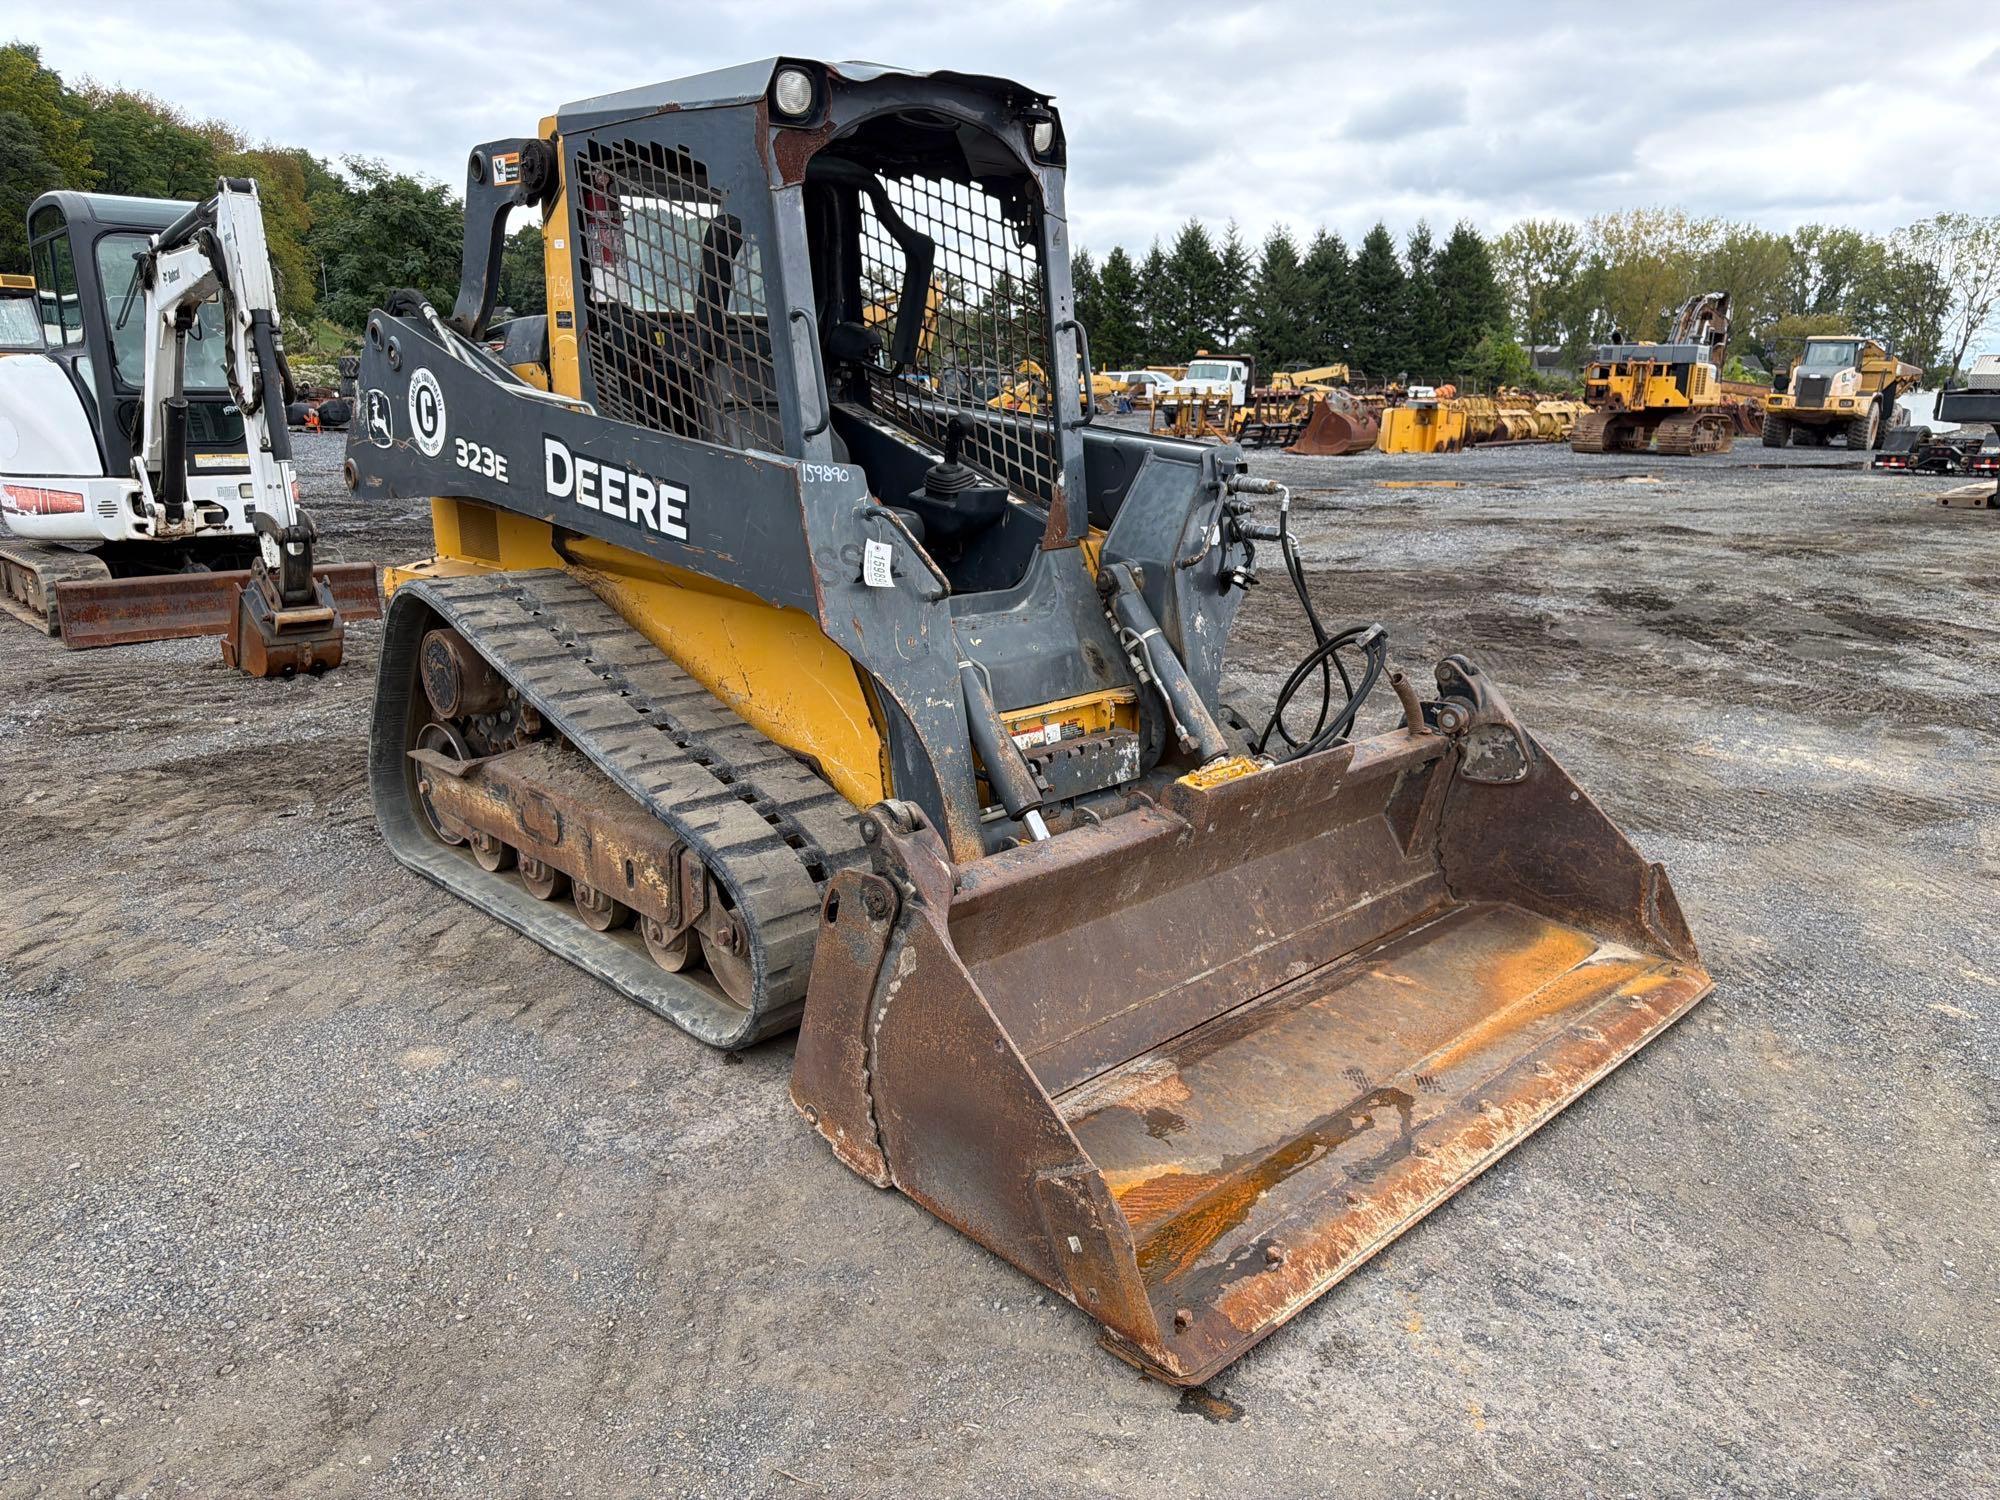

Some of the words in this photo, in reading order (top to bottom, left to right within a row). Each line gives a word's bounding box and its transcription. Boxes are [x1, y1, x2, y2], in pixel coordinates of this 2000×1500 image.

[420, 390, 434, 432] C
[455, 438, 509, 484] 323E
[802, 463, 849, 483] 159890
[545, 438, 687, 540] DEERE
